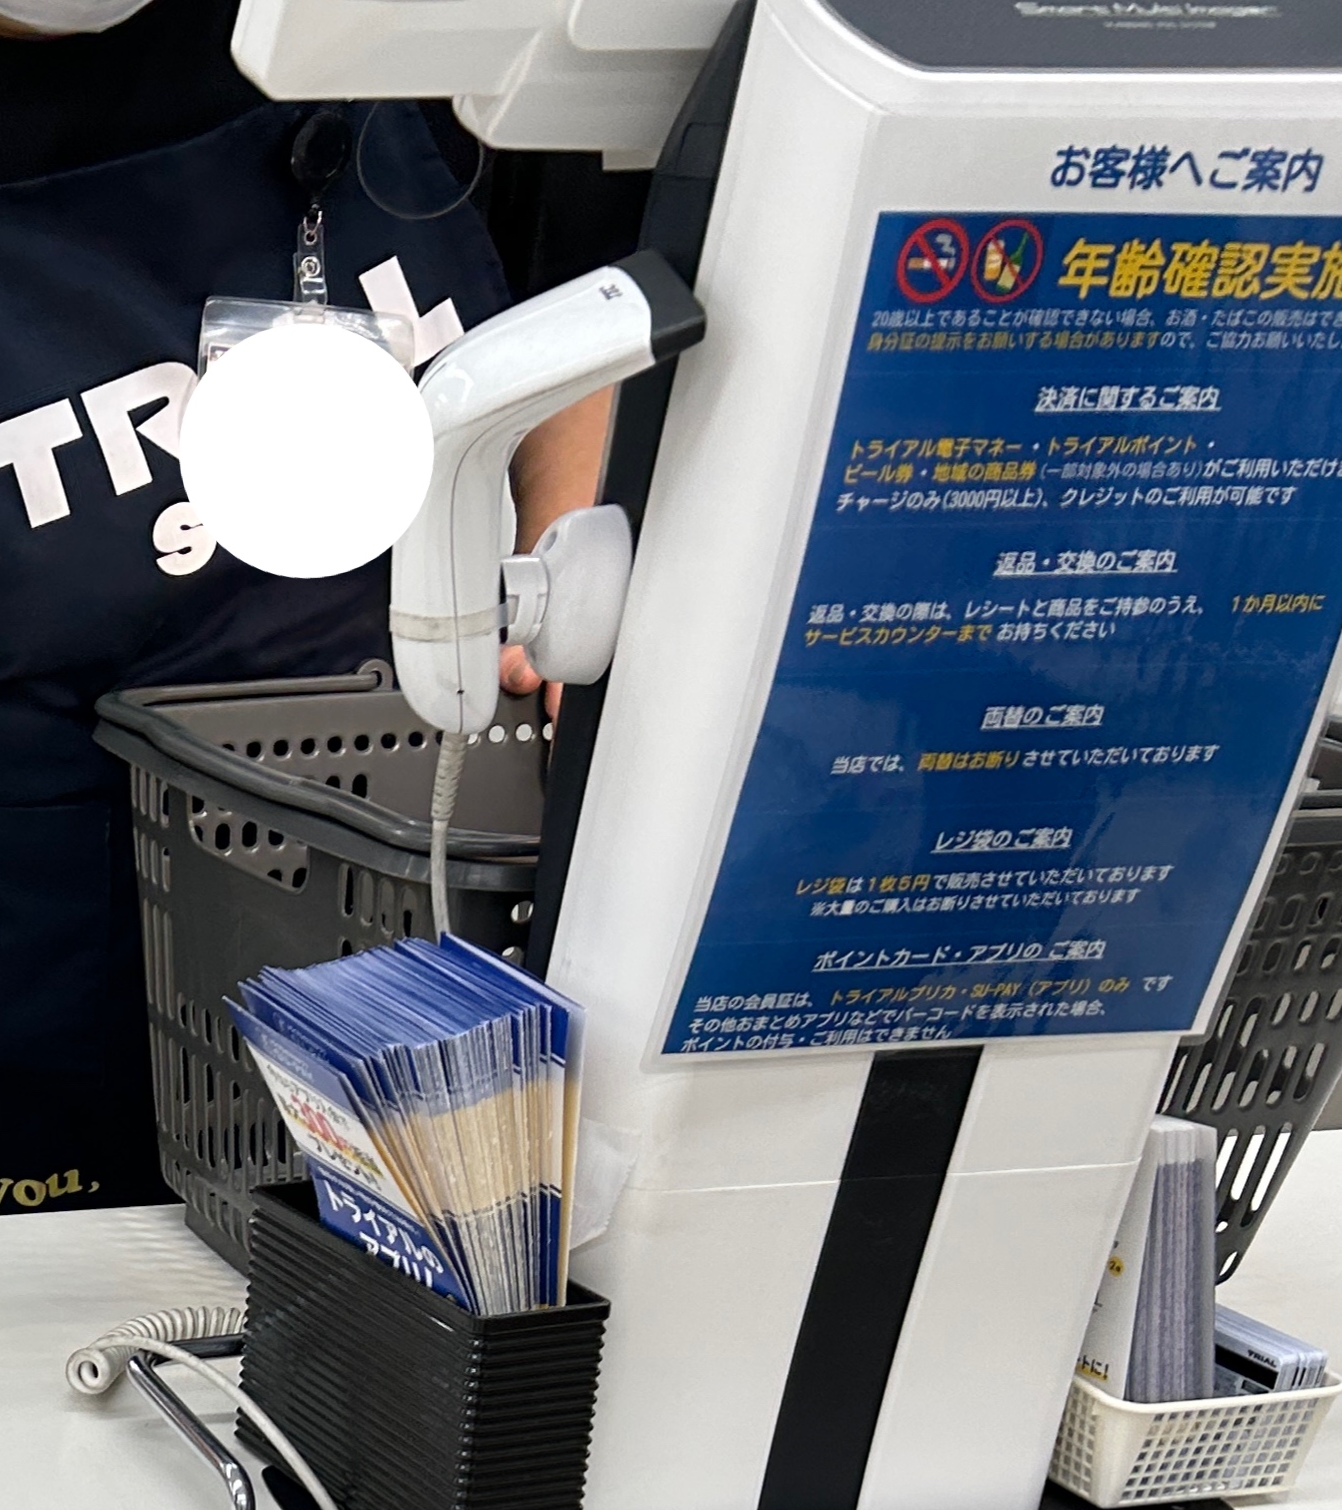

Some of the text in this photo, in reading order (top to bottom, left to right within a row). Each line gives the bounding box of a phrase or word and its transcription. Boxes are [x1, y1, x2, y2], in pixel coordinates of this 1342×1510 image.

[1050, 144, 1325, 192] お客様へご案内
[1035, 385, 1222, 411] 決済に関するご案内
[994, 549, 1178, 574] 返品・交換のご案内
[981, 704, 1104, 730] 両替のご案内
[931, 827, 1074, 853] レジ袋のご案内
[323, 1180, 445, 1275] トライアルの
